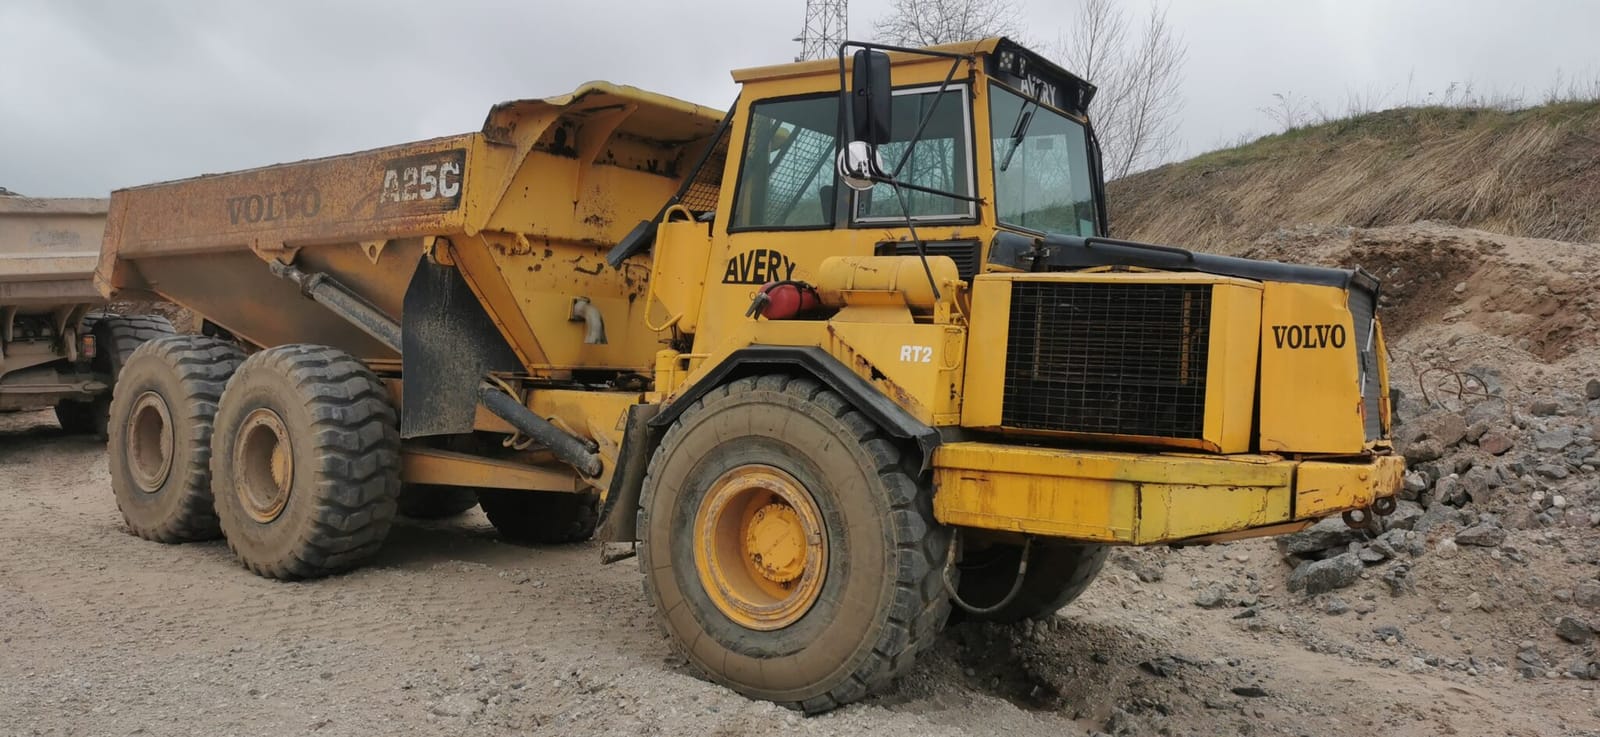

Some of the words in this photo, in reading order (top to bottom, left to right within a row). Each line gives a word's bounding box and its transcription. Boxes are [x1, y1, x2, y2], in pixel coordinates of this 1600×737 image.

[380, 161, 460, 203] A25C
[226, 187, 321, 225] VOLVO
[721, 249, 796, 284] AVERY
[900, 345, 932, 363] RT2
[1272, 324, 1346, 349] VOLVO
